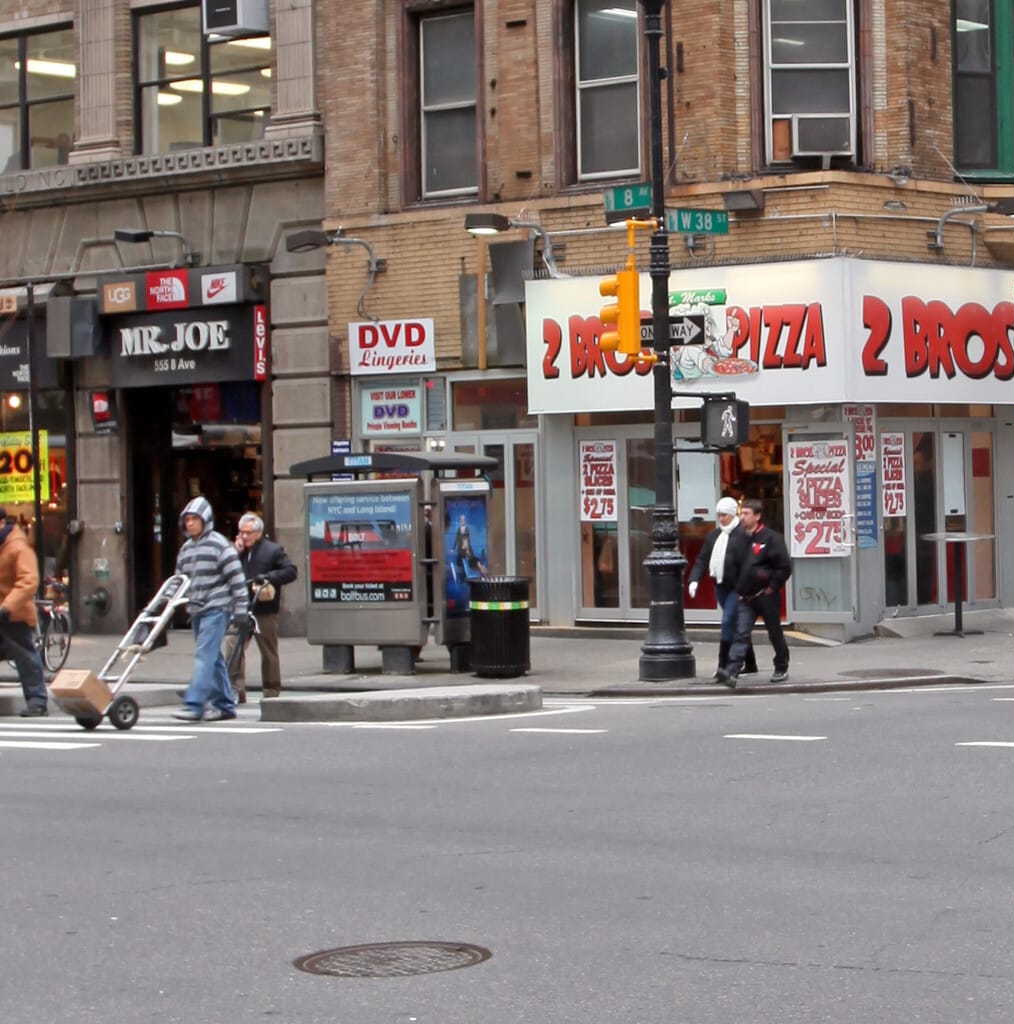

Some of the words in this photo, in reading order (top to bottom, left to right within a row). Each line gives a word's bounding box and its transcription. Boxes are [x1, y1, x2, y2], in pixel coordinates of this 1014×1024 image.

[623, 189, 634, 206] 8
[639, 187, 649, 196] AV
[681, 213, 693, 229] W
[695, 213, 713, 230] 38
[717, 214, 727, 223] ST
[159, 277, 173, 286] THE
[107, 287, 131, 304] UGG
[150, 286, 174, 295] NORTH
[681, 292, 716, 304] Marks
[171, 320, 231, 352] JOE
[358, 322, 426, 349] DVD
[671, 325, 694, 337] WAY
[862, 295, 892, 376] 2
[543, 318, 562, 379] 2
[726, 302, 827, 371] PIZZA
[178, 358, 196, 370] Ave
[358, 349, 428, 370] Lingeries
[372, 404, 410, 419] DVD
[590, 463, 615, 475] PIZZA
[792, 458, 846, 478] Special
[796, 477, 804, 494] 2
[806, 477, 844, 493] PIZZA
[799, 488, 842, 509] SLICES
[327, 506, 341, 514] NYC
[356, 506, 374, 515] Long
[340, 590, 386, 601] boltbus.com
